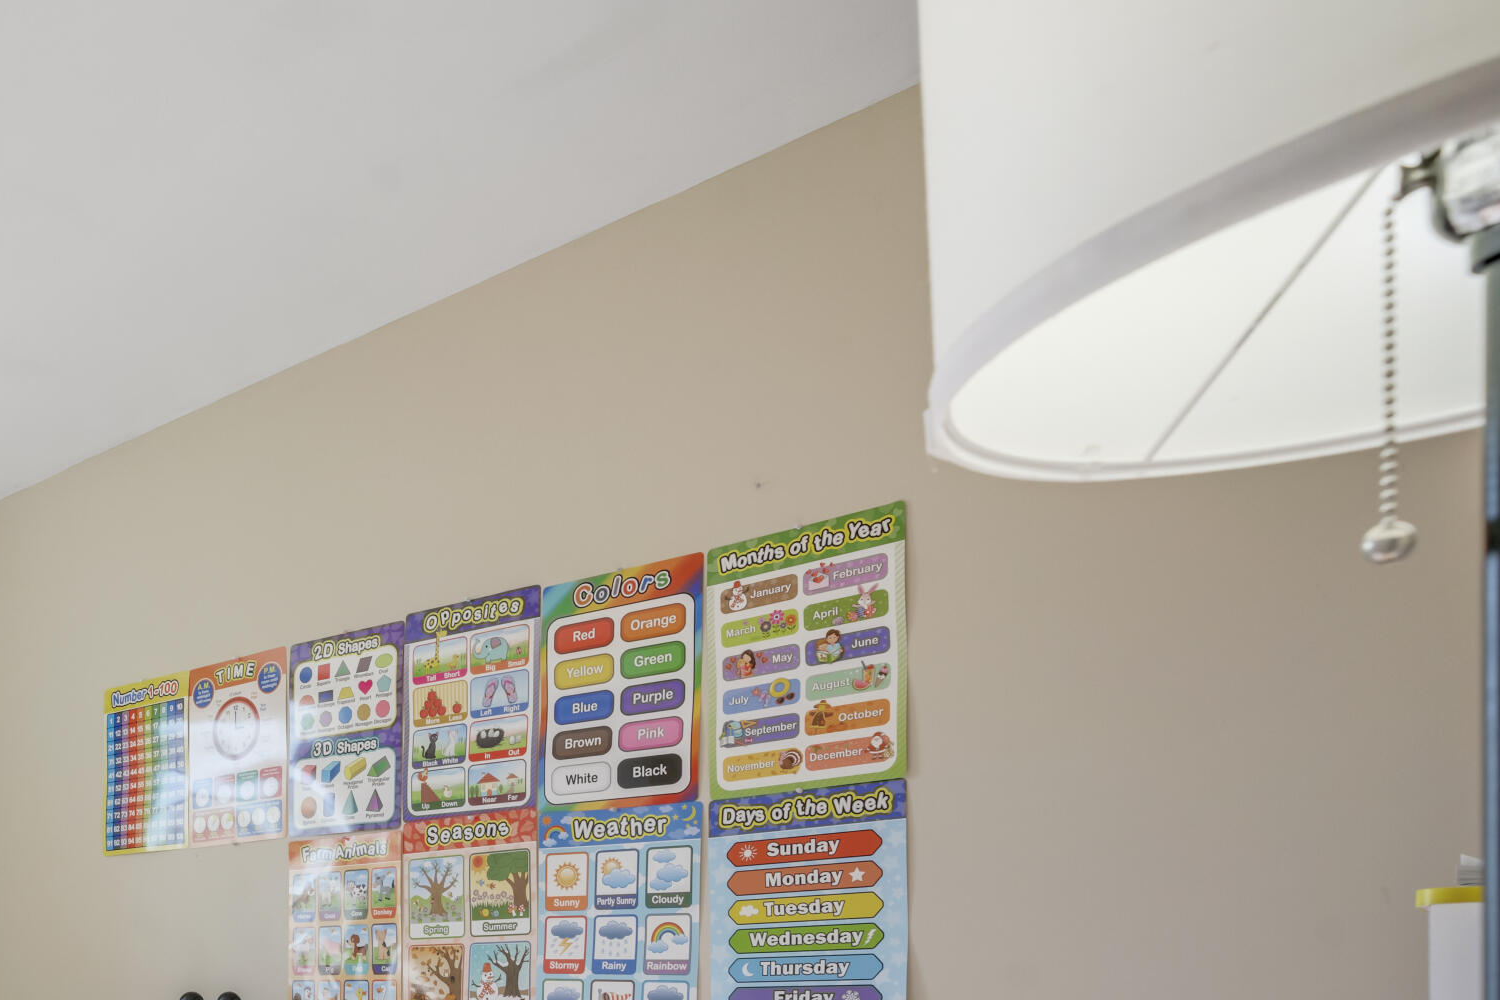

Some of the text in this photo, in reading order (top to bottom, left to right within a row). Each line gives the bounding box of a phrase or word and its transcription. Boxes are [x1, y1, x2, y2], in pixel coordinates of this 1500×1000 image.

[719, 517, 892, 574] Months of the Year
[833, 563, 883, 581] February
[573, 570, 671, 608] Colors
[749, 583, 791, 599] January
[426, 600, 520, 630] Opposites
[812, 607, 838, 621] April
[630, 614, 677, 631] Orange
[573, 629, 595, 642] Red
[726, 626, 756, 638] March
[314, 638, 378, 660] 2D Shapes
[851, 636, 879, 649] June
[634, 653, 672, 667] Green
[772, 653, 793, 664] May
[215, 663, 255, 684] TIME
[566, 664, 604, 679] Yellow
[811, 678, 851, 691] August
[112, 689, 147, 707] Number
[148, 680, 179, 699] 1-100
[633, 690, 673, 705] Purple
[572, 702, 598, 714] Blue
[728, 696, 749, 706] July
[838, 708, 884, 722] October
[637, 728, 664, 740] Pink
[745, 722, 797, 737] September
[314, 740, 377, 757] 3D Shapes
[565, 736, 601, 749] Brown
[809, 747, 863, 762] December
[633, 765, 667, 777] Black
[727, 759, 775, 773] November
[566, 773, 598, 785] White
[721, 791, 889, 826] Days of the Week
[426, 820, 511, 845] Seasons
[573, 816, 668, 840] Weather
[335, 840, 387, 859] Animals
[767, 838, 839, 857] Sunday
[765, 870, 843, 888] Monday
[554, 899, 580, 908] Sunny
[597, 897, 636, 906] Partly Sunny
[652, 895, 684, 905] Cloudy
[764, 900, 845, 917] Tuesday
[423, 925, 449, 936] Spring
[483, 923, 517, 932] Summer
[750, 930, 863, 947] Wednesday
[550, 962, 579, 970] Stormy
[602, 962, 626, 971] Rainy
[647, 961, 687, 971] Rainbow
[760, 960, 849, 977] Thursday
